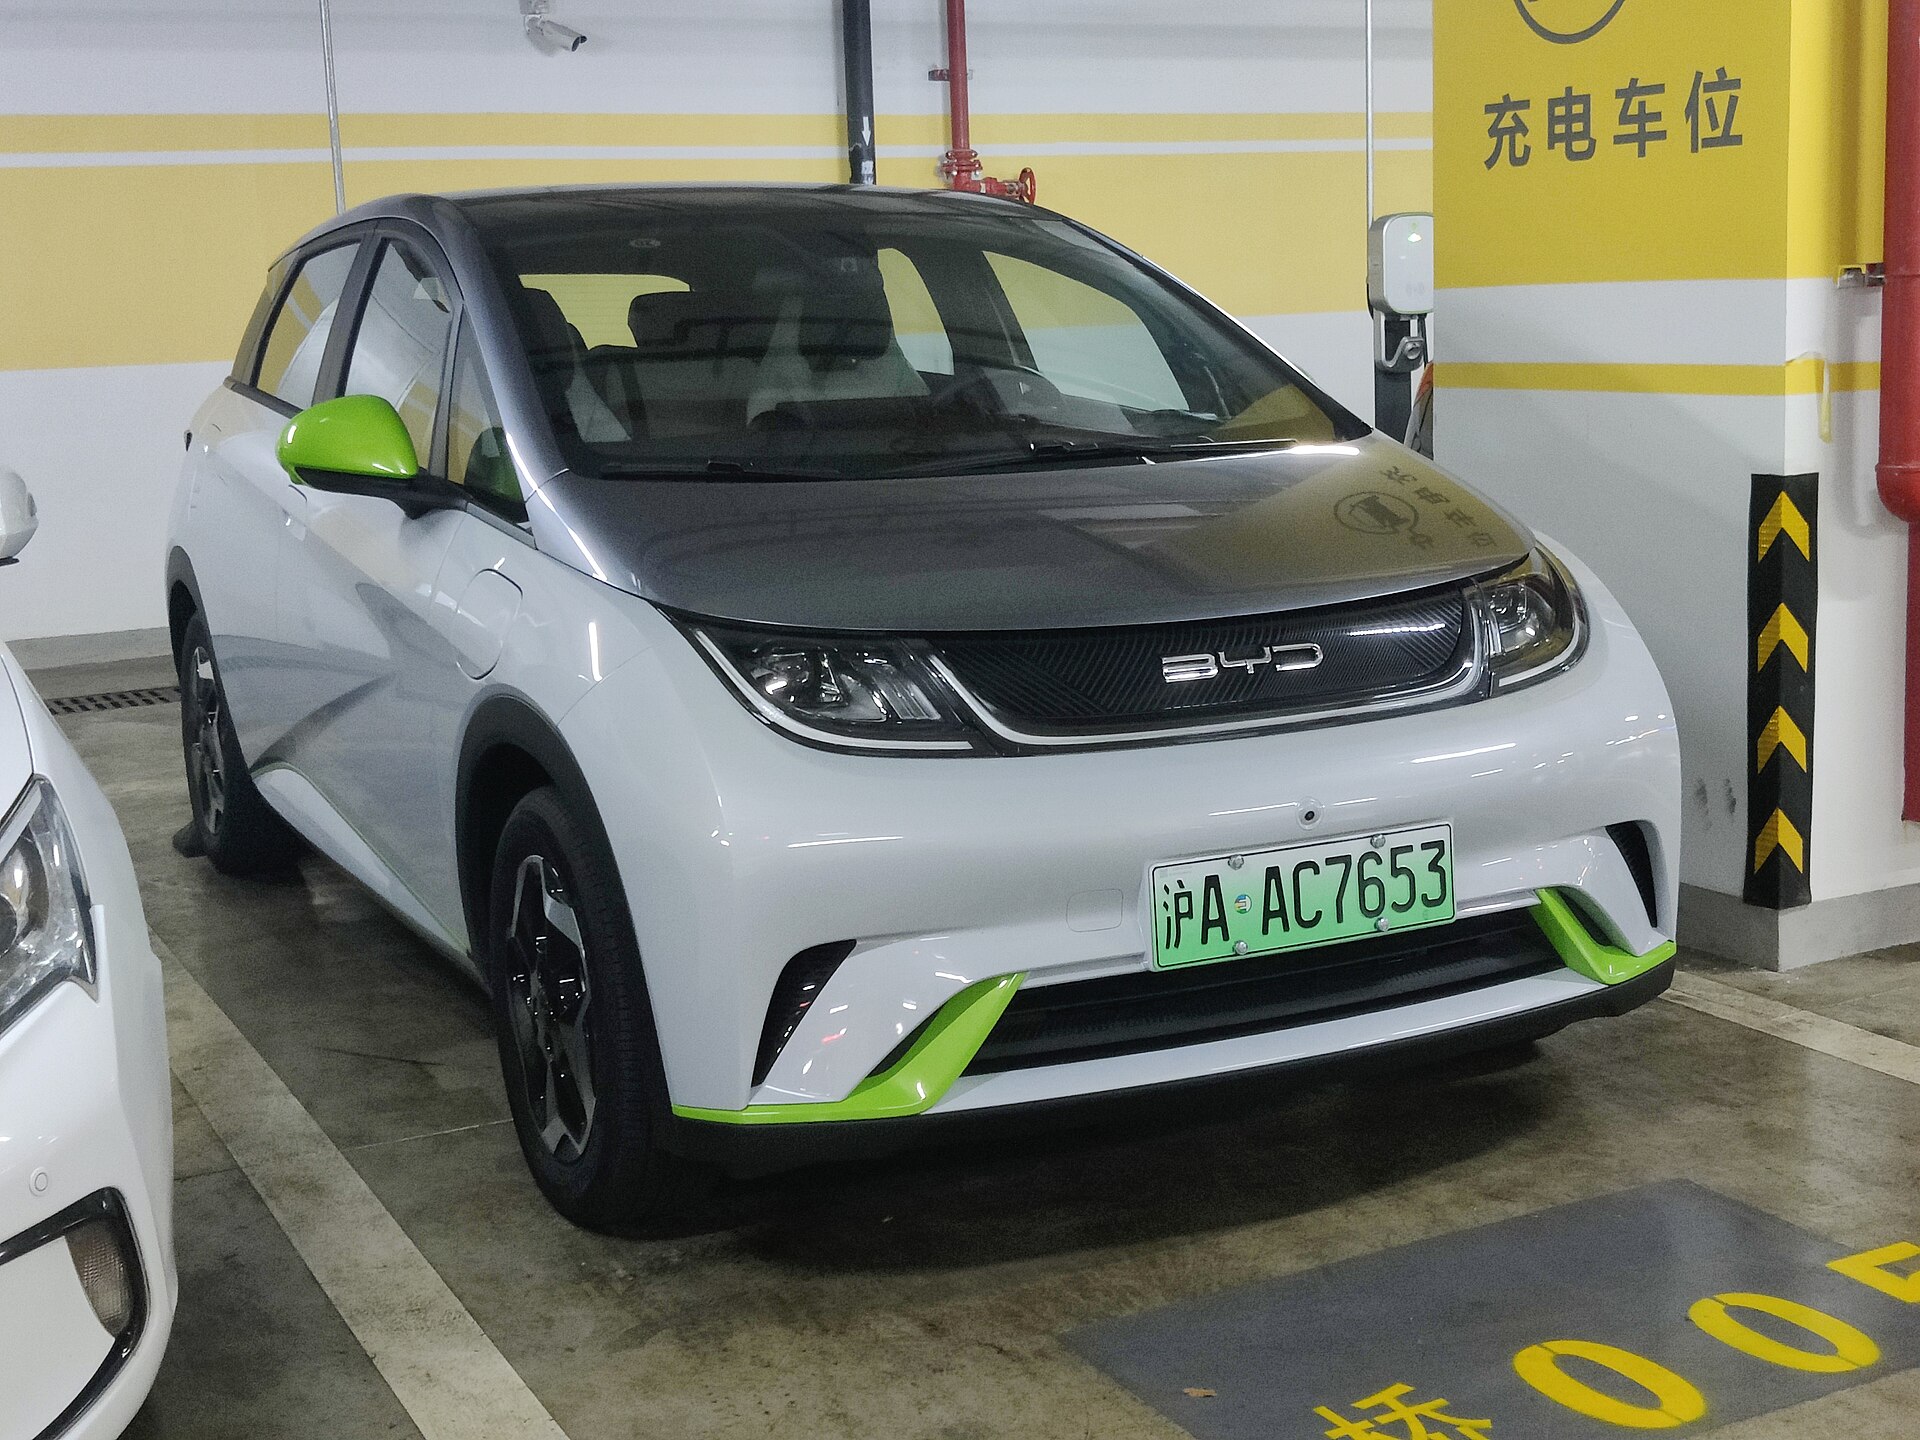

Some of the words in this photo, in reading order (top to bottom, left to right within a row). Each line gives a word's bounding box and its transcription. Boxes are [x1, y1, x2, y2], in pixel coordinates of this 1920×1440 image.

[1483, 66, 1743, 171] 充电车位
[1161, 642, 1324, 683] BYD
[1261, 840, 1447, 935] AC7653
